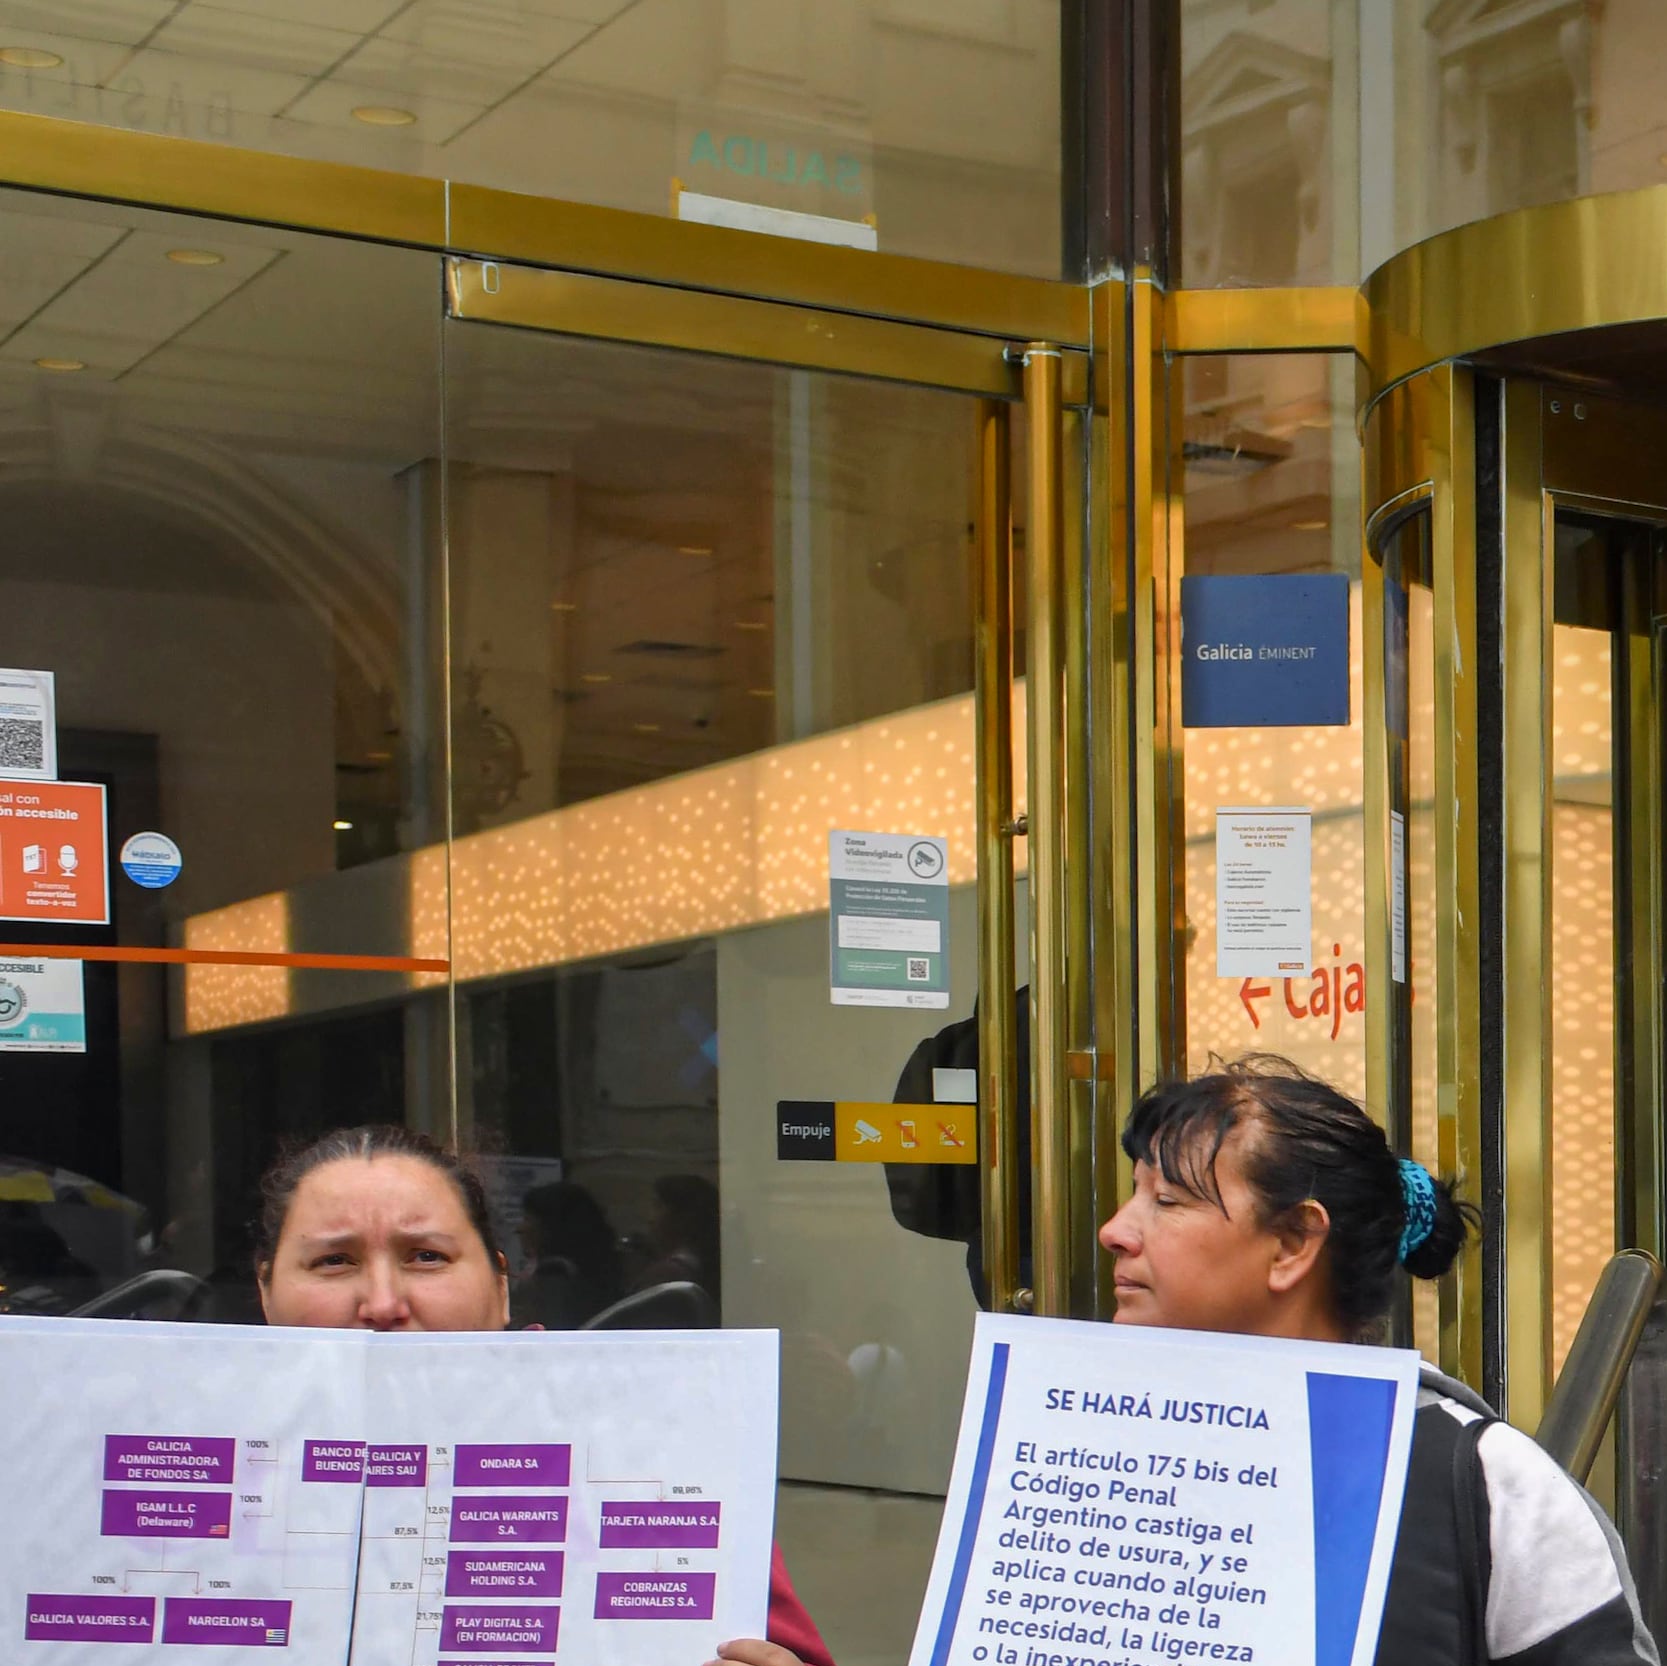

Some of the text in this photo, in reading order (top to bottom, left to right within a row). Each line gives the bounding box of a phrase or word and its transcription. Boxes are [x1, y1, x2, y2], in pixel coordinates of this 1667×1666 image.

[1196, 643, 1316, 662] Galicia ÉMINENT
[16, 808, 78, 820] accesible
[0, 964, 44, 974] CCESIBLE
[1284, 943, 1366, 1041] Caja
[781, 1122, 831, 1141] Empuje
[1044, 1387, 1270, 1431] SE HARÁ JUSTICIA
[147, 1441, 192, 1452] GALICIA
[118, 1454, 220, 1466] ADMINISTRADORA
[480, 1458, 538, 1469] ONDARA SA
[1014, 1440, 1277, 1488] El artículo 175 bis del
[128, 1468, 208, 1480] DE FONDOS SA
[1009, 1469, 1177, 1507] Código Penal
[136, 1502, 196, 1514] IGAM L.L.C
[137, 1516, 194, 1528] (Delaware)
[601, 1516, 720, 1526] TARJETA NARANJA S.A.
[1002, 1499, 1253, 1545] Argentino castiga el
[465, 1562, 546, 1572] SUDAMERICANA
[470, 1576, 537, 1586] HOLDING S.A.
[624, 1582, 688, 1592] COBRANZAS
[610, 1596, 698, 1607] REGIONALES S.A.
[188, 1616, 265, 1627] NARGELON SA
